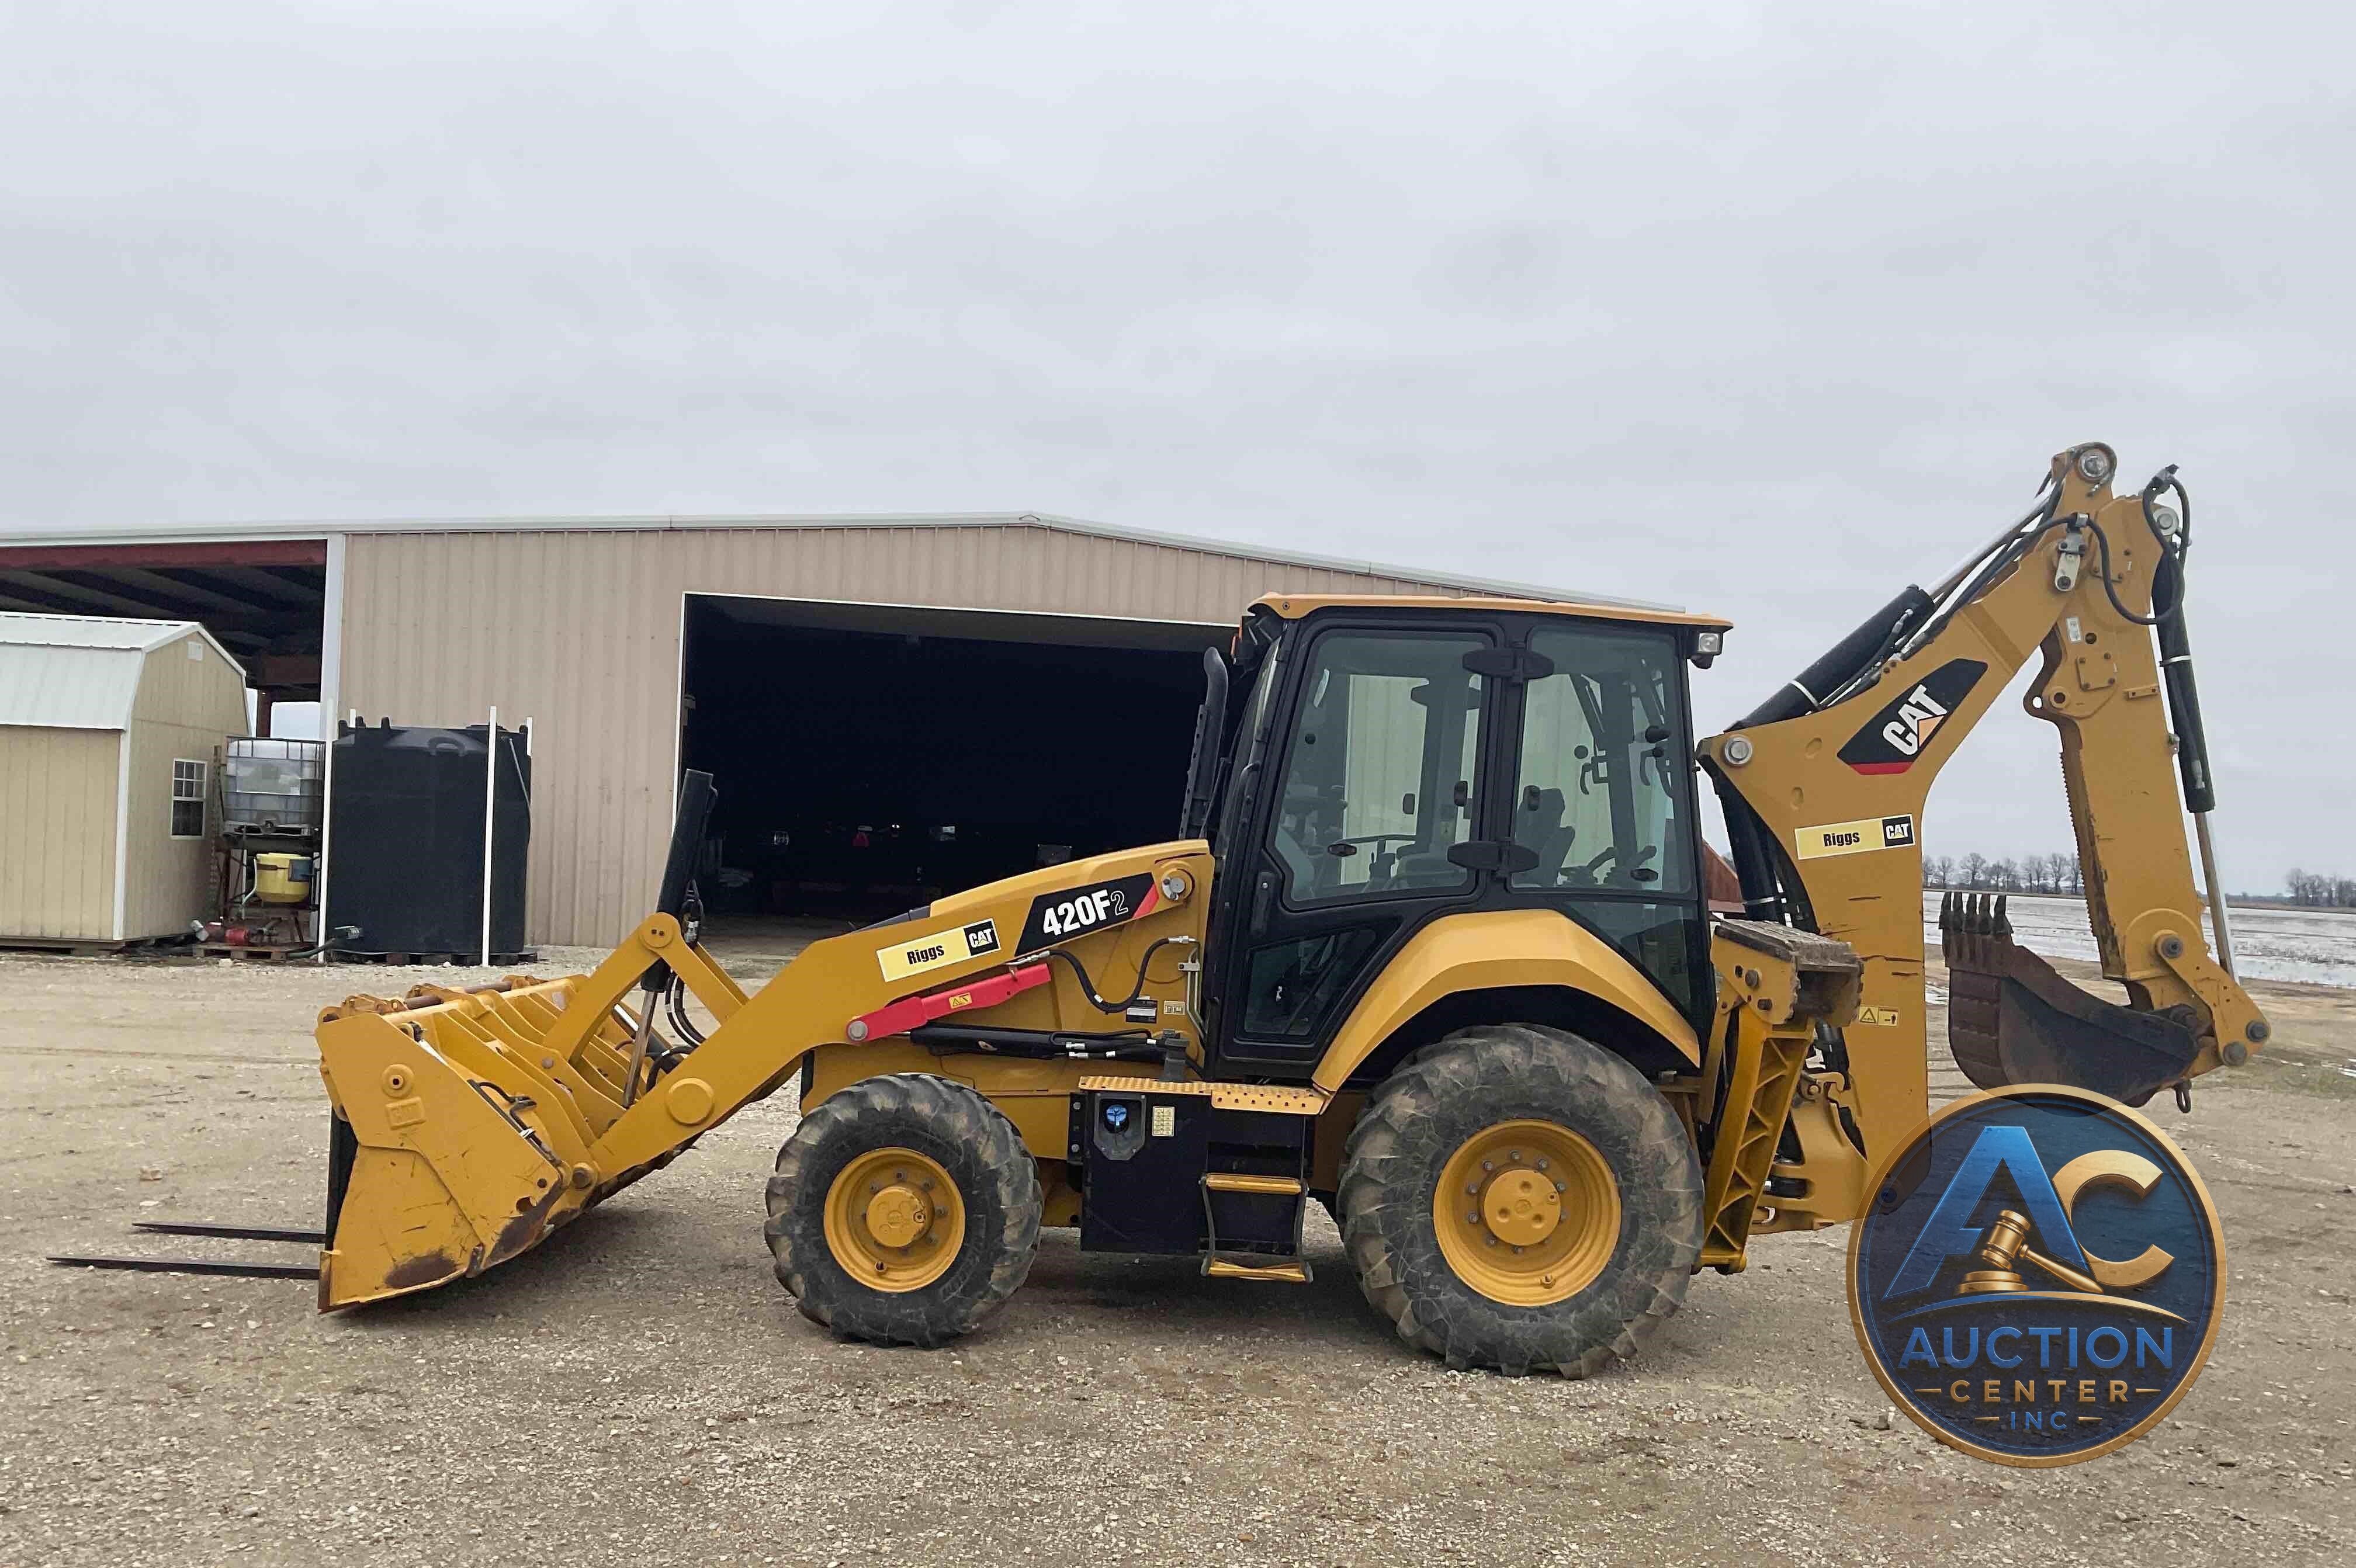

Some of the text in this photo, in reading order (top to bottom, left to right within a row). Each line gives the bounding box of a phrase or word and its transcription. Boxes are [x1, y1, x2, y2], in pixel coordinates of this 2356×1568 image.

[1883, 684, 1948, 755] CAT
[1823, 823, 1909, 847] Riggs CAT
[906, 928, 993, 965] Riggs CAT
